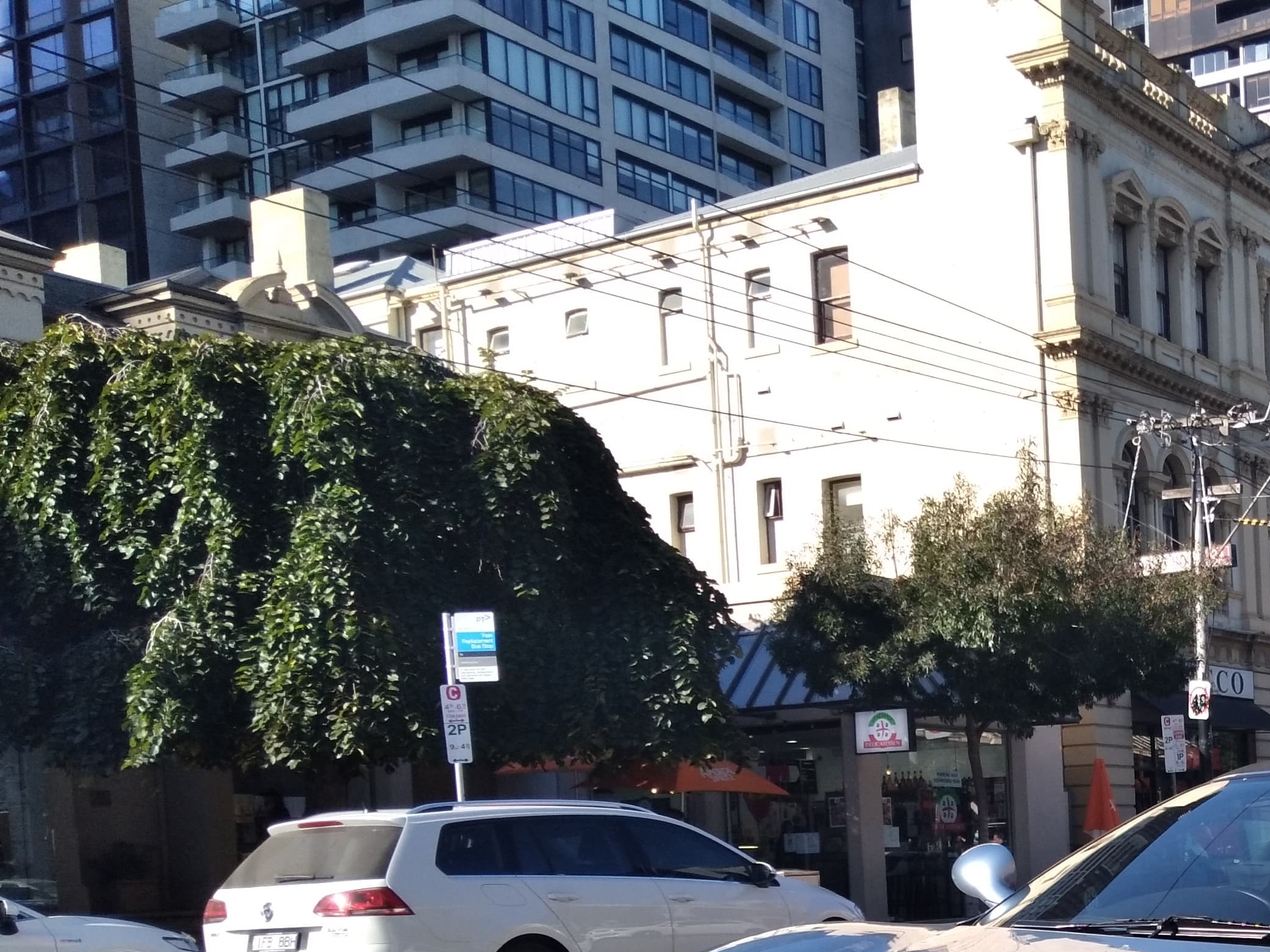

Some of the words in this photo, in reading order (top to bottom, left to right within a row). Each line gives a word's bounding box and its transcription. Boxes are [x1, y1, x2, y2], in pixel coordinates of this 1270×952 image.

[1209, 669, 1244, 696] CO
[448, 686, 458, 700] C
[447, 724, 467, 736] 2P
[1165, 736, 1173, 744] 2P
